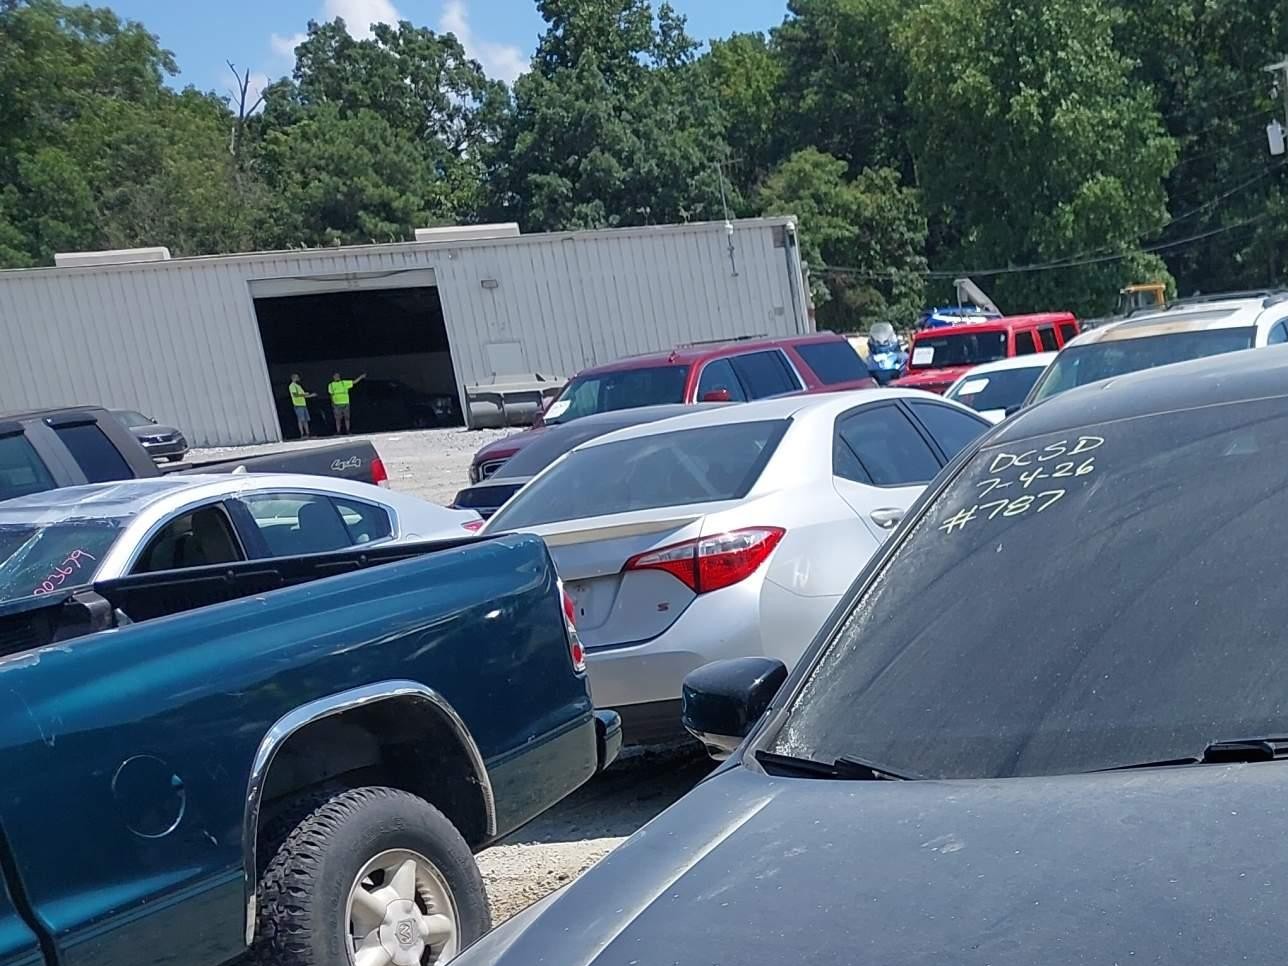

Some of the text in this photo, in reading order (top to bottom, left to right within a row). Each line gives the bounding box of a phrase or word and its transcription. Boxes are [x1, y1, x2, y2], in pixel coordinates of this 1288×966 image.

[989, 436, 1105, 474] DCSD
[976, 457, 1096, 499] 7-4-26
[938, 489, 1066, 534] #787
